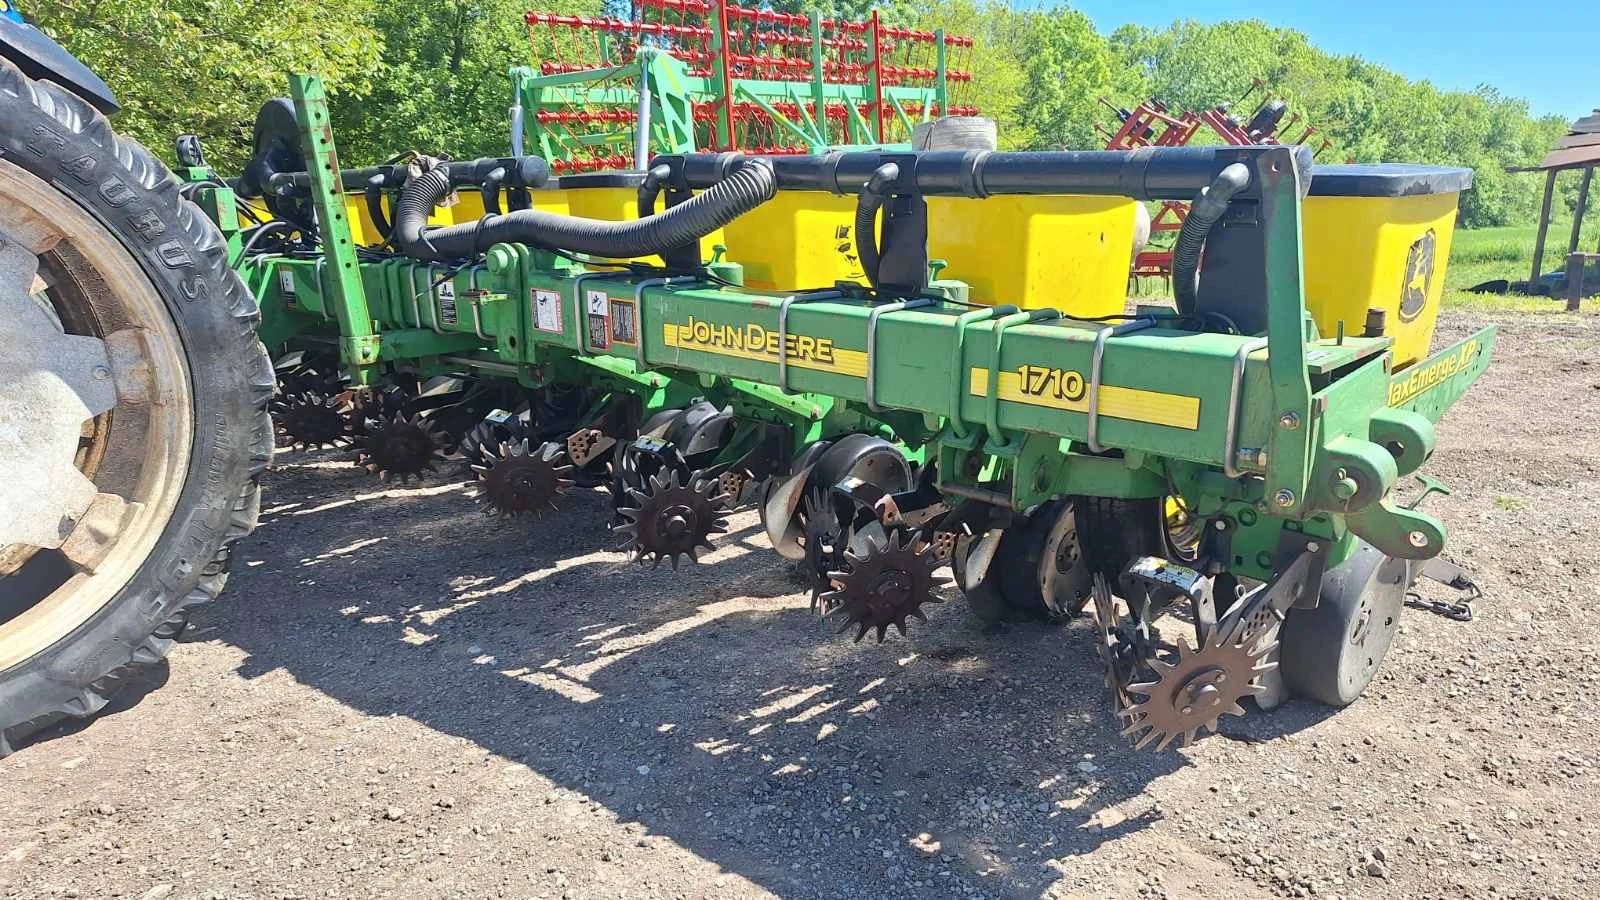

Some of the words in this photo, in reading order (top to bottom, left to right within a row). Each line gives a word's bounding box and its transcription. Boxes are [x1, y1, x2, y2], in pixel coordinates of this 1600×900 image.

[26, 124, 208, 302] TAURUS
[680, 315, 743, 351] JOHN
[747, 323, 834, 365] DEERE
[1456, 339, 1477, 370] XP
[1018, 364, 1086, 401] 1710
